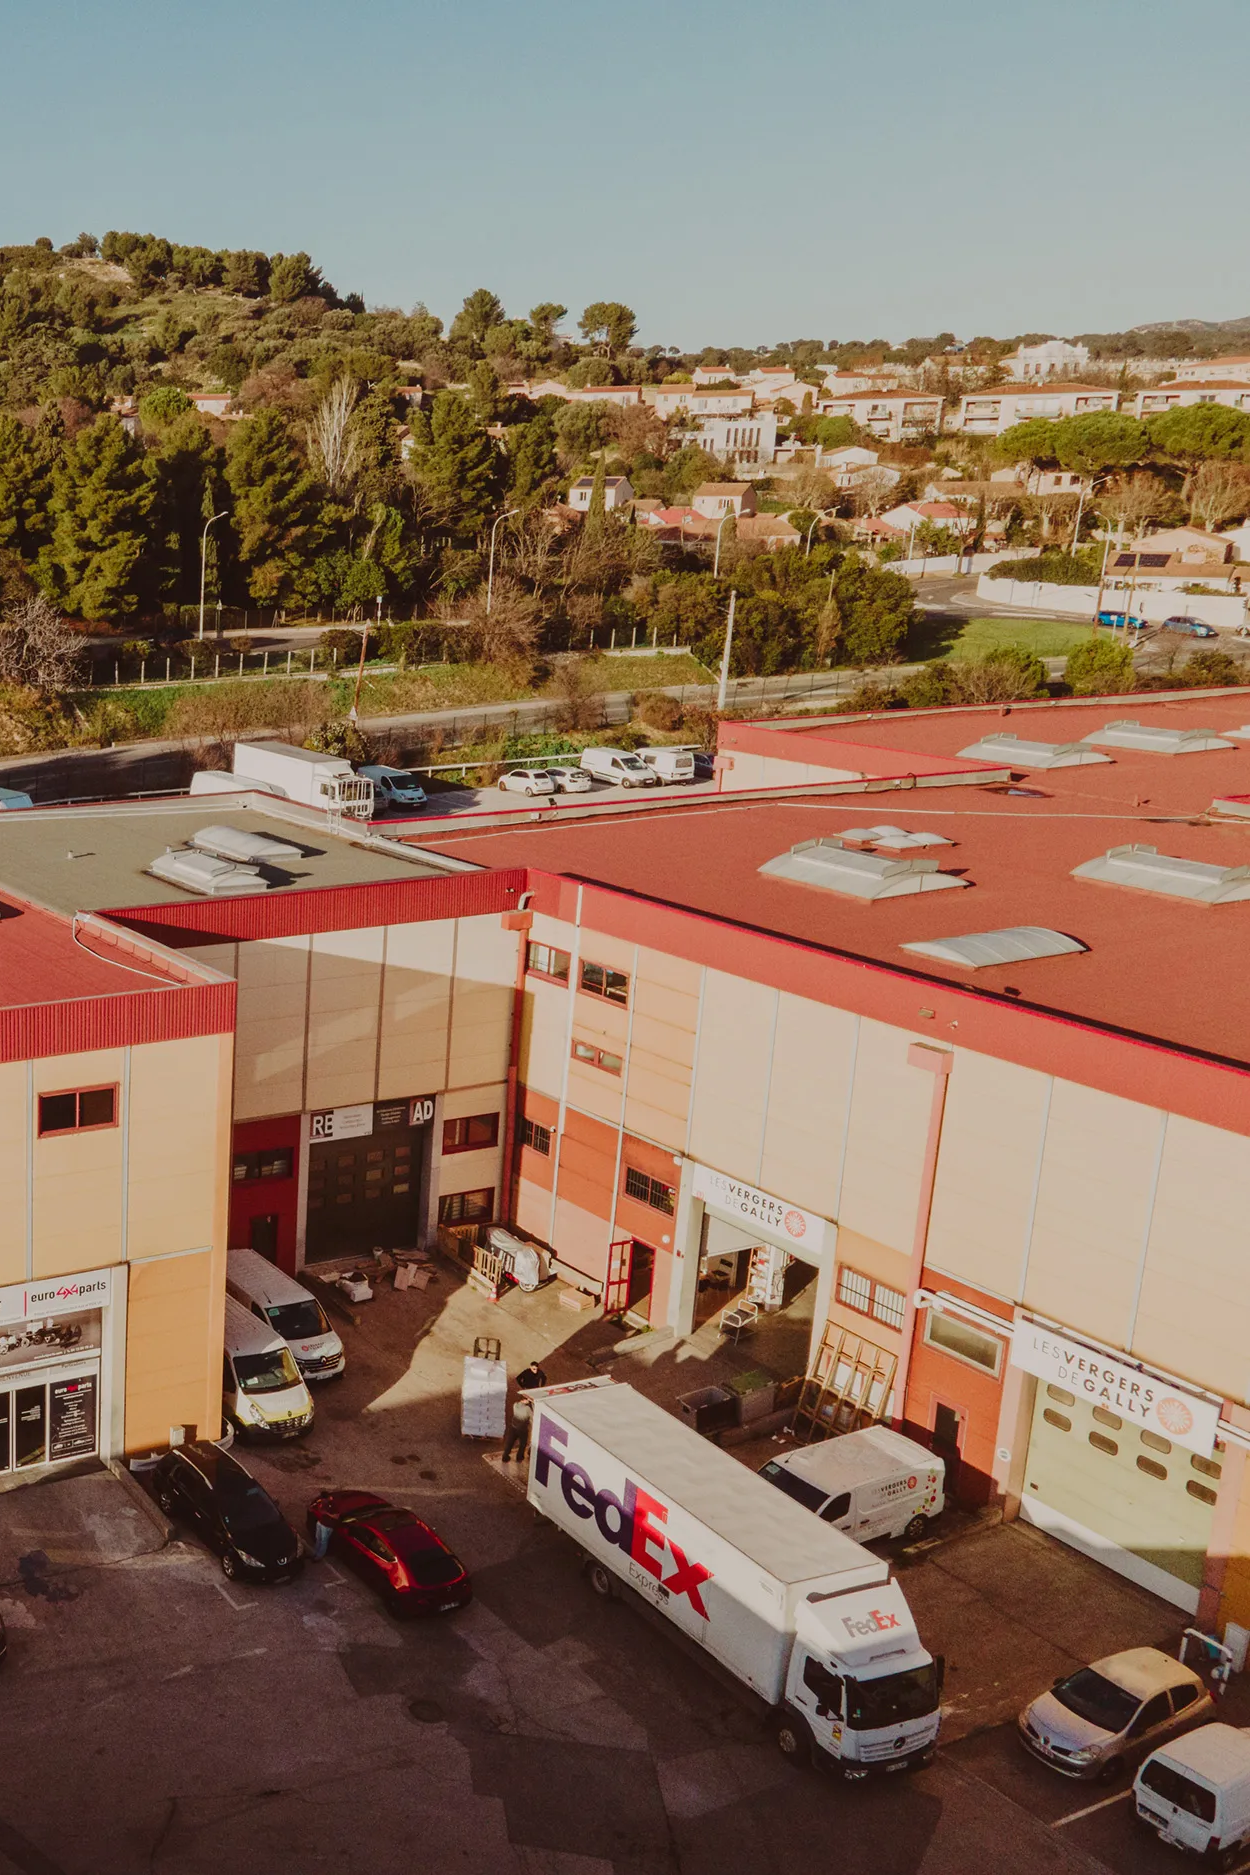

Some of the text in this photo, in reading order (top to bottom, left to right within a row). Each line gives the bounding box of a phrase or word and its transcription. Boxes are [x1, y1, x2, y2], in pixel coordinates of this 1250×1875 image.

[413, 1100, 434, 1122] AD
[535, 1413, 714, 1623] FedEx
[628, 1561, 670, 1606] Express
[841, 1609, 901, 1638] FedEx
